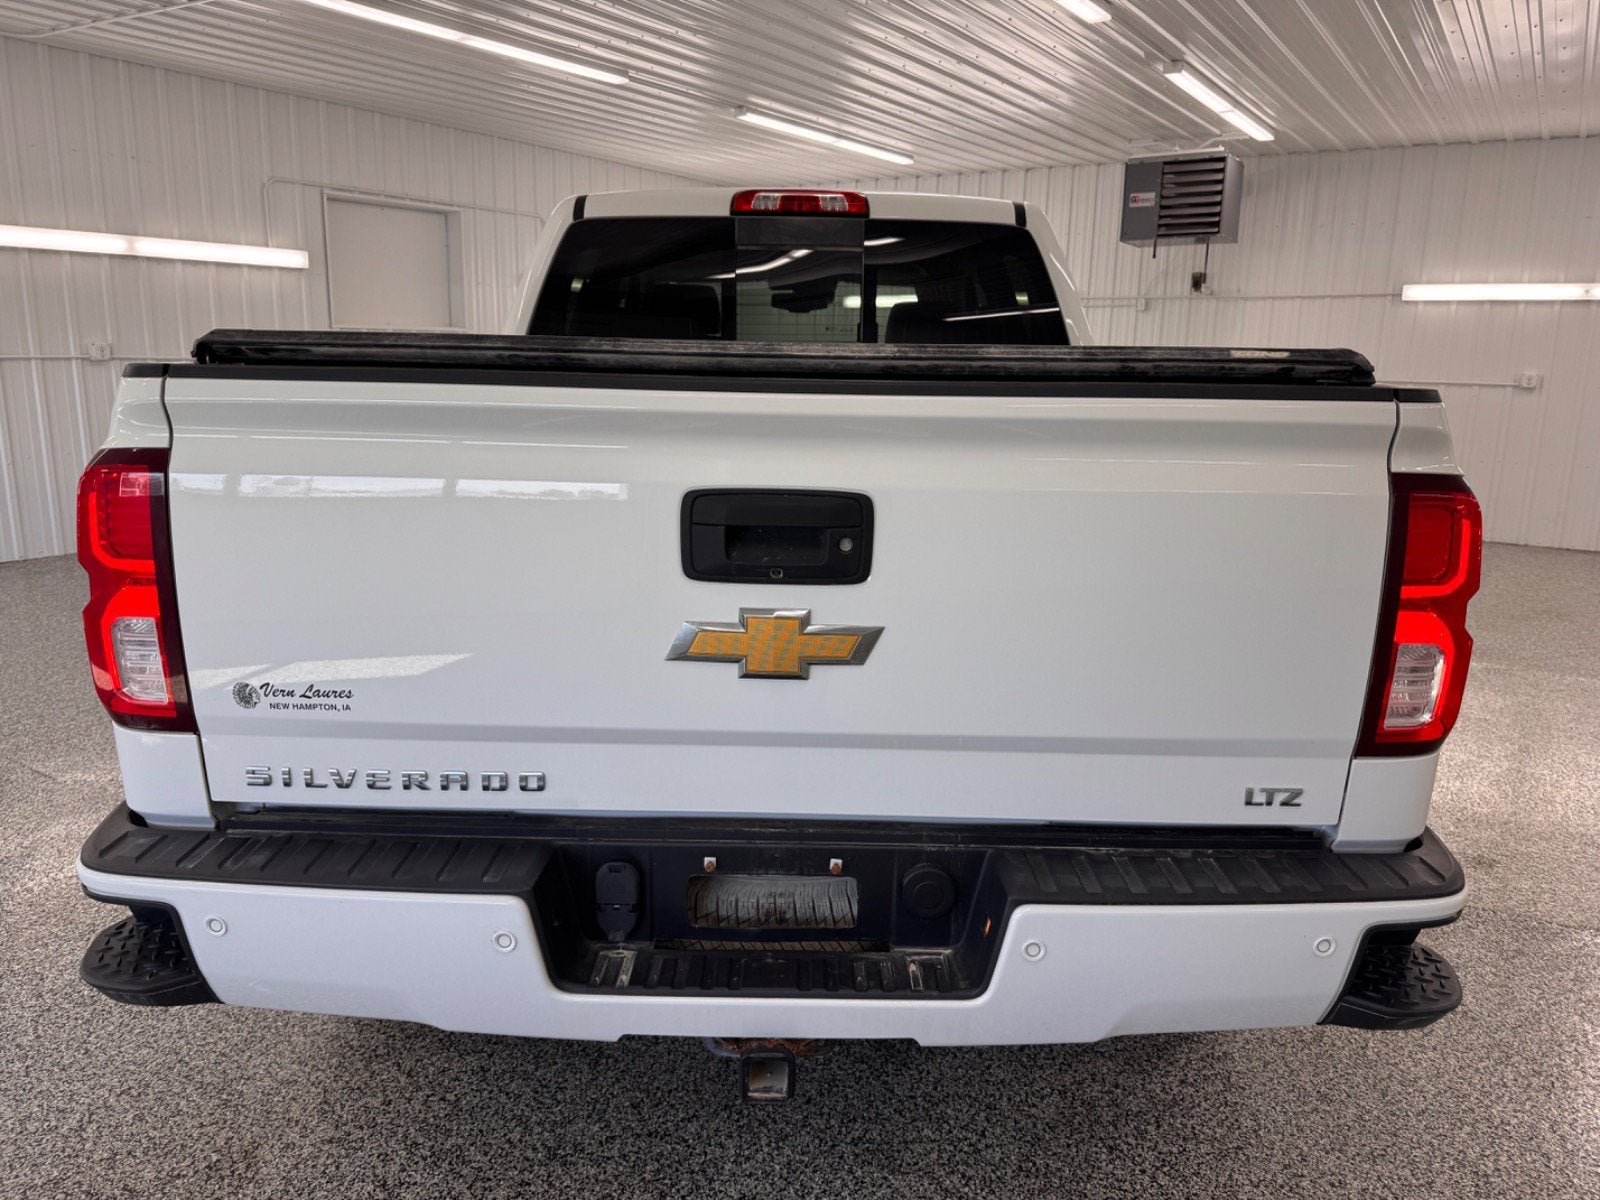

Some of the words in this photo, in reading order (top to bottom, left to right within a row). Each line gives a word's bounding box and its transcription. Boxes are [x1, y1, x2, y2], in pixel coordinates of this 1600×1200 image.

[259, 682, 296, 698] Vern
[299, 684, 354, 699] Laures
[269, 702, 290, 710] NEW
[292, 703, 340, 712] HAMPTON,
[245, 766, 547, 792] SILVERADO
[1244, 787, 1304, 807] LTZ
